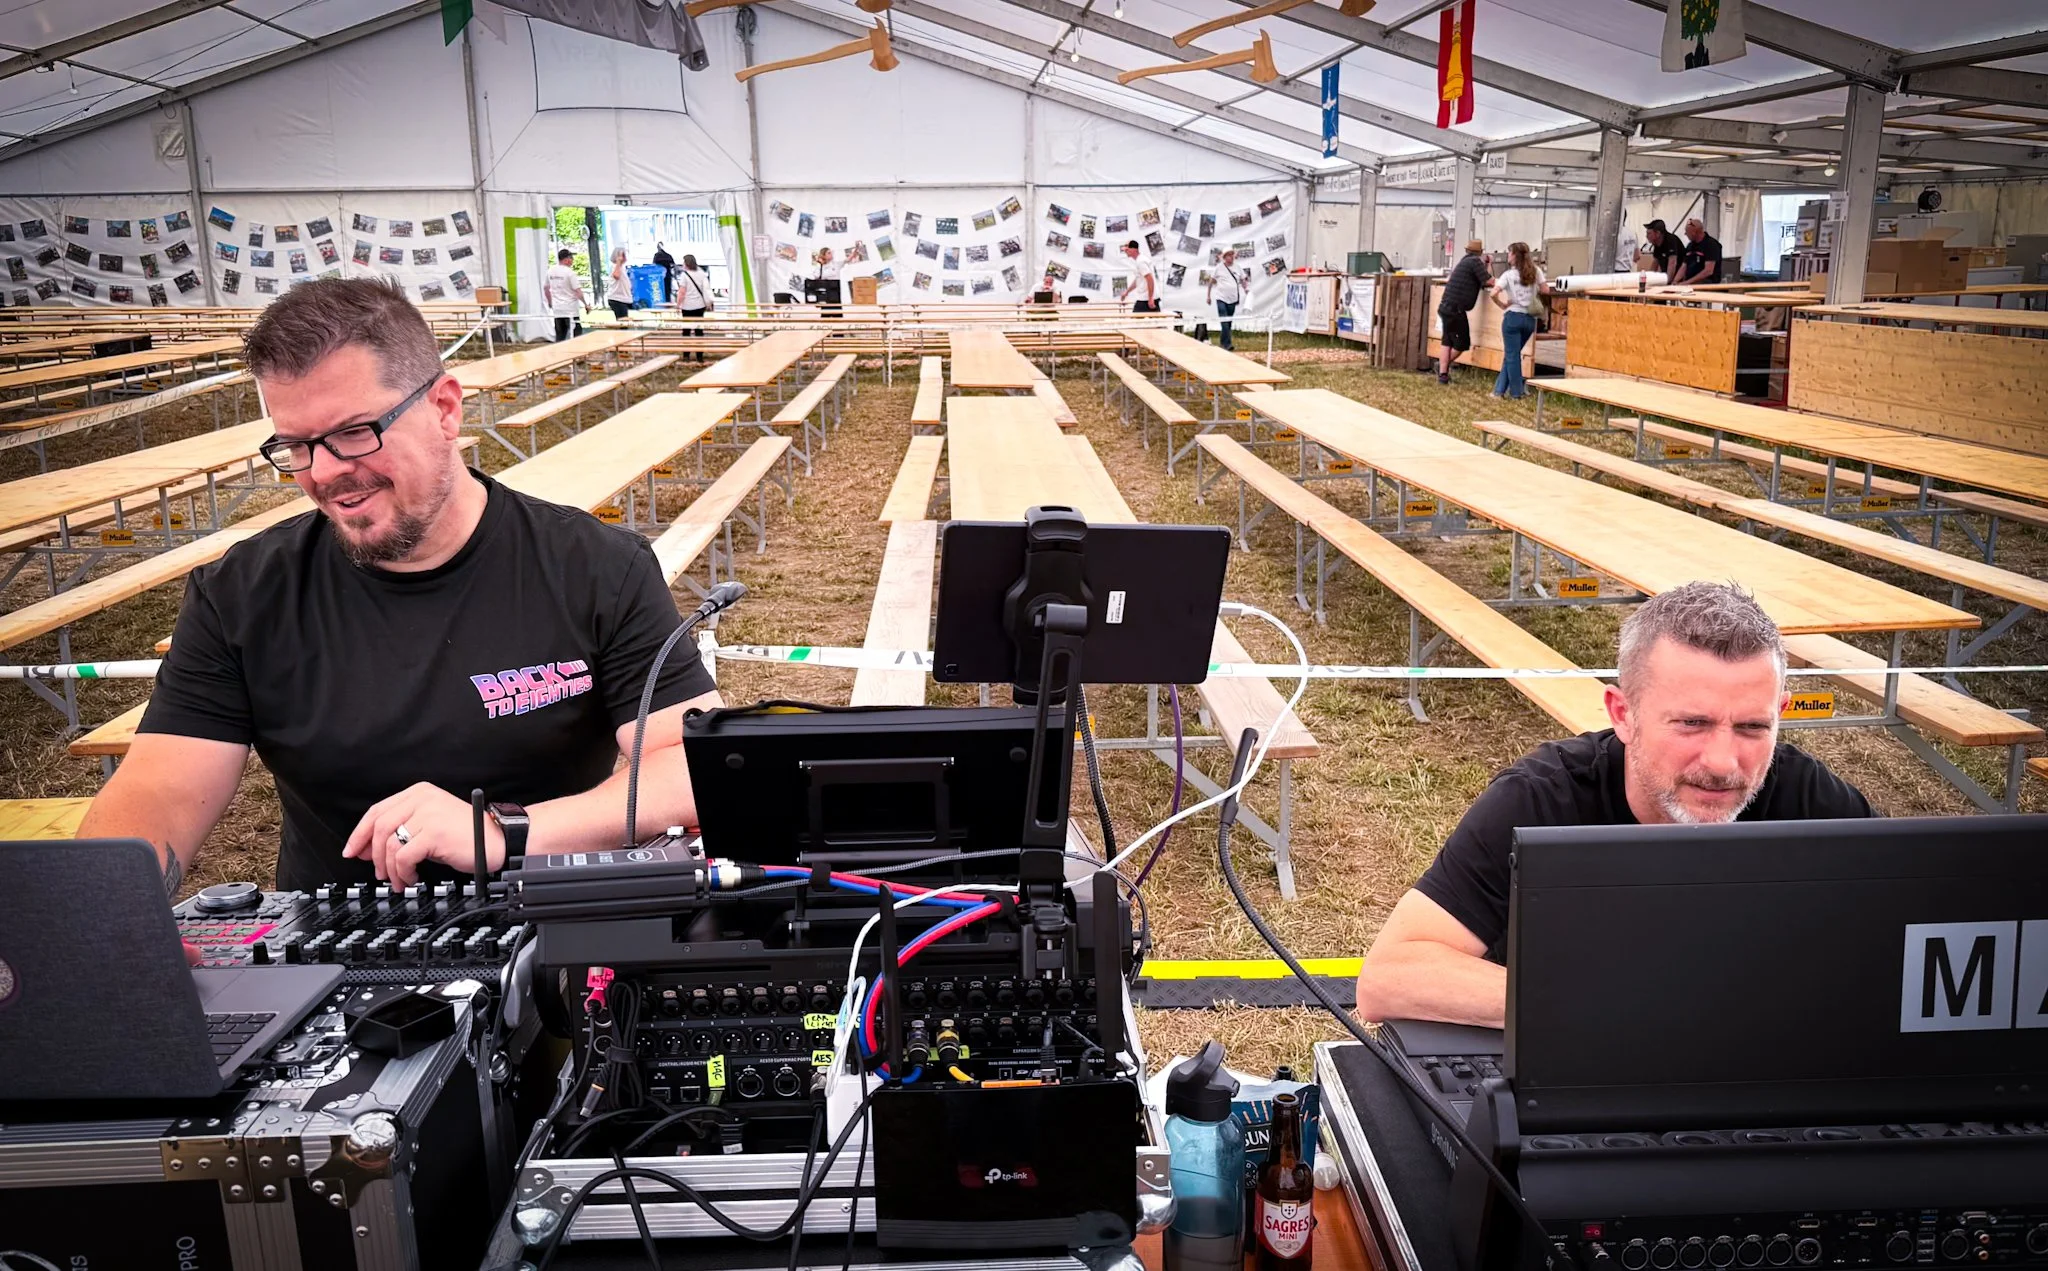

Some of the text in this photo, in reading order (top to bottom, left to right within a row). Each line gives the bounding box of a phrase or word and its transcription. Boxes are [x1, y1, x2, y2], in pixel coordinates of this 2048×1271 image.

[1568, 583, 1597, 593] Muller
[469, 663, 565, 702] BACK
[484, 675, 593, 719] TO EIGHTIES
[1793, 700, 1832, 711] Muller
[1921, 935, 2048, 1018] M
[813, 1053, 832, 1064] AES
[711, 1060, 723, 1081] MAC
[1002, 1172, 1028, 1181] tp-link
[1265, 1216, 1309, 1233] SAGRES
[1278, 1232, 1298, 1240] MINI
[176, 1236, 199, 1271] PRO
